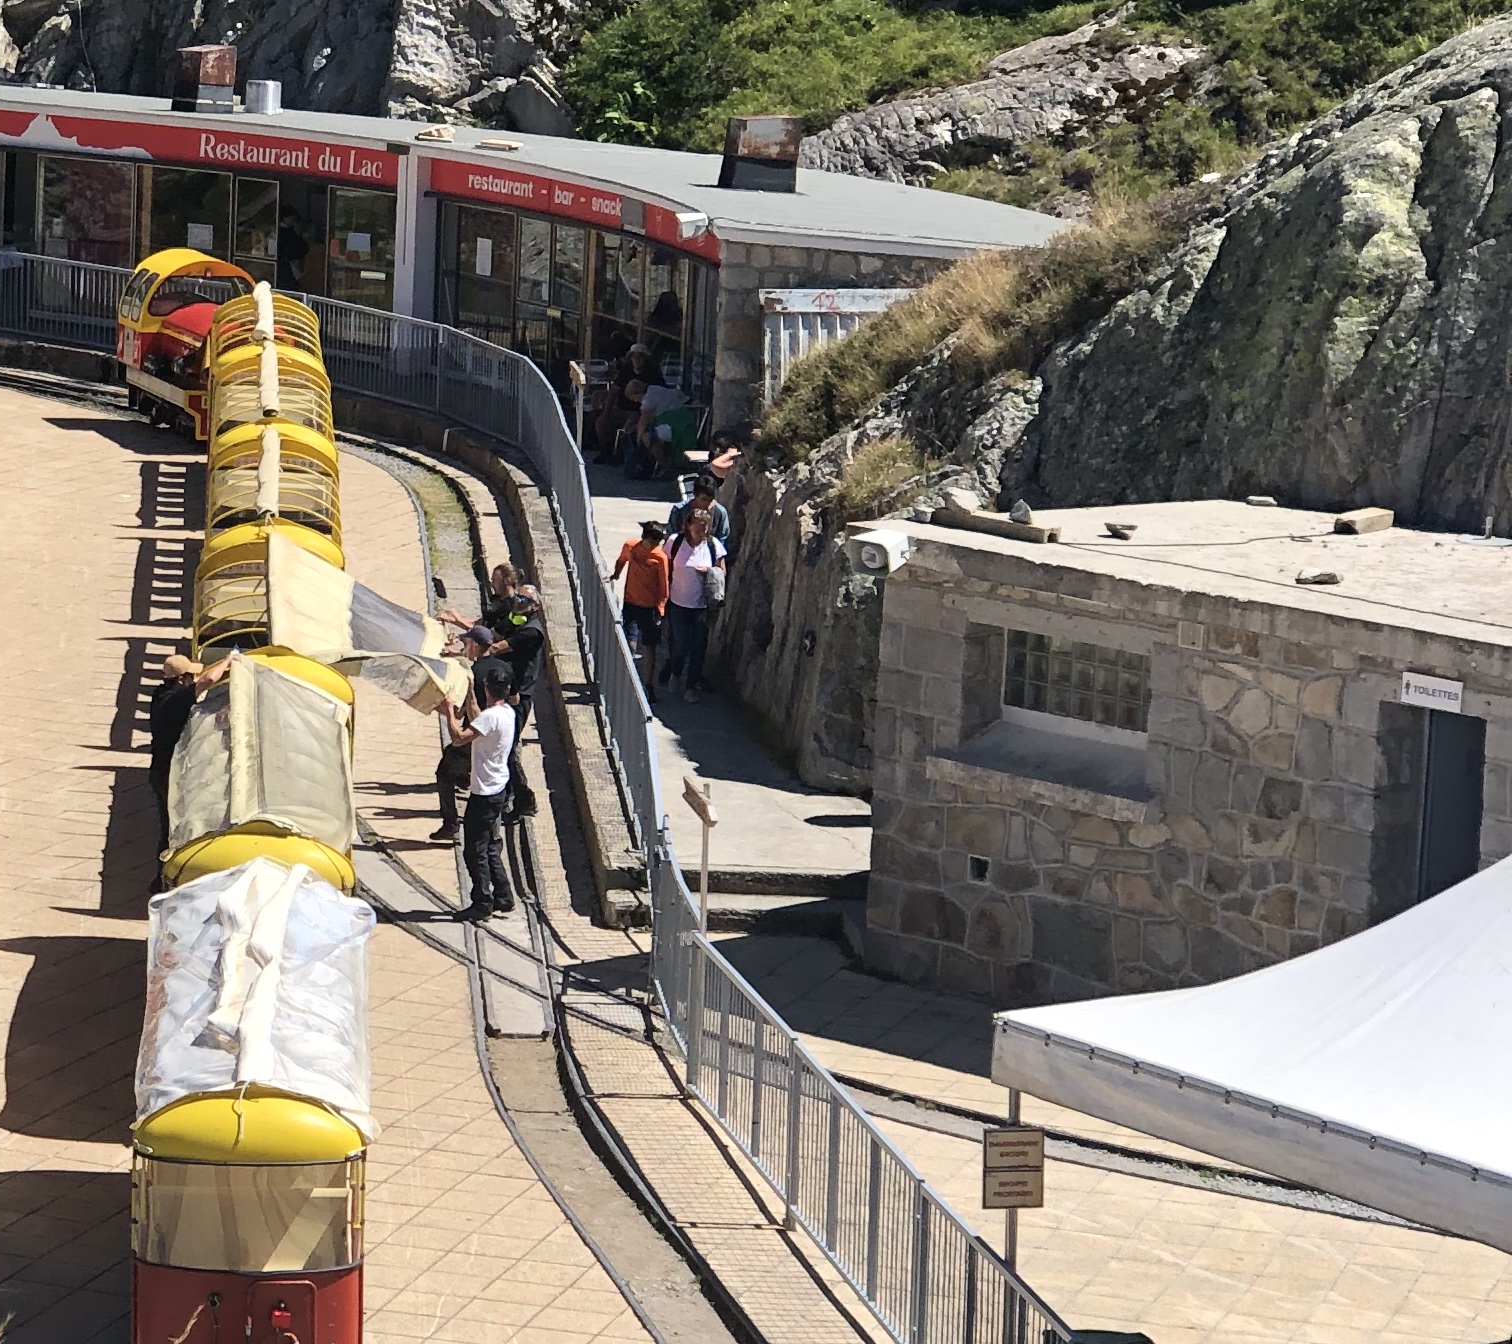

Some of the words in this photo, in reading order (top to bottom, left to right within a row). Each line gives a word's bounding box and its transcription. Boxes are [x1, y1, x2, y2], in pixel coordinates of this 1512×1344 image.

[199, 132, 310, 170] Restaurant
[318, 146, 341, 174] du
[348, 149, 383, 179] Lac
[468, 173, 533, 198] restaurant
[554, 185, 575, 206] bar
[591, 196, 622, 217] snack
[1413, 685, 1459, 702] TOILETTES
